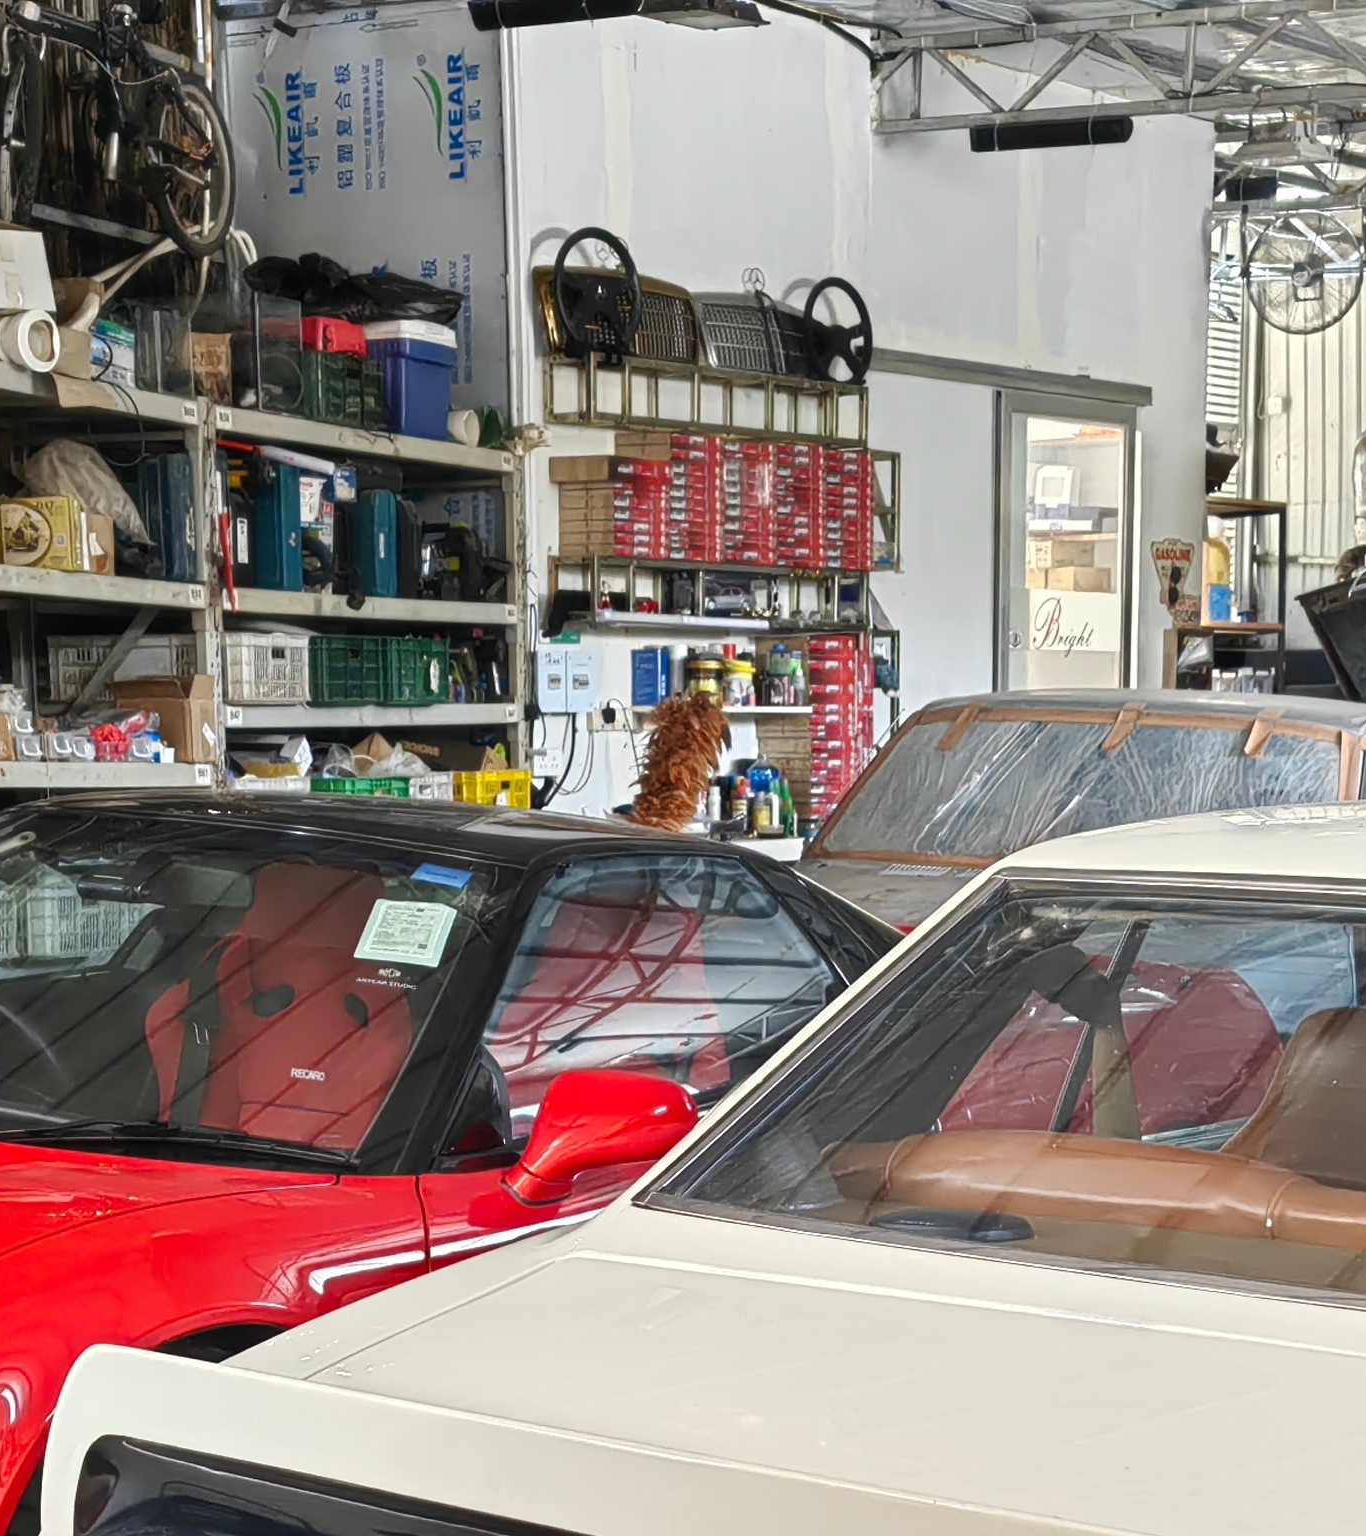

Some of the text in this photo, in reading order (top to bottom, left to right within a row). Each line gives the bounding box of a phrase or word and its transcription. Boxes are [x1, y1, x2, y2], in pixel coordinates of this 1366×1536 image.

[285, 71, 304, 195] LIKEAIR
[446, 54, 464, 180] LIKEAIR
[1032, 597, 1095, 658] Bright
[291, 1067, 325, 1082] RECARO
